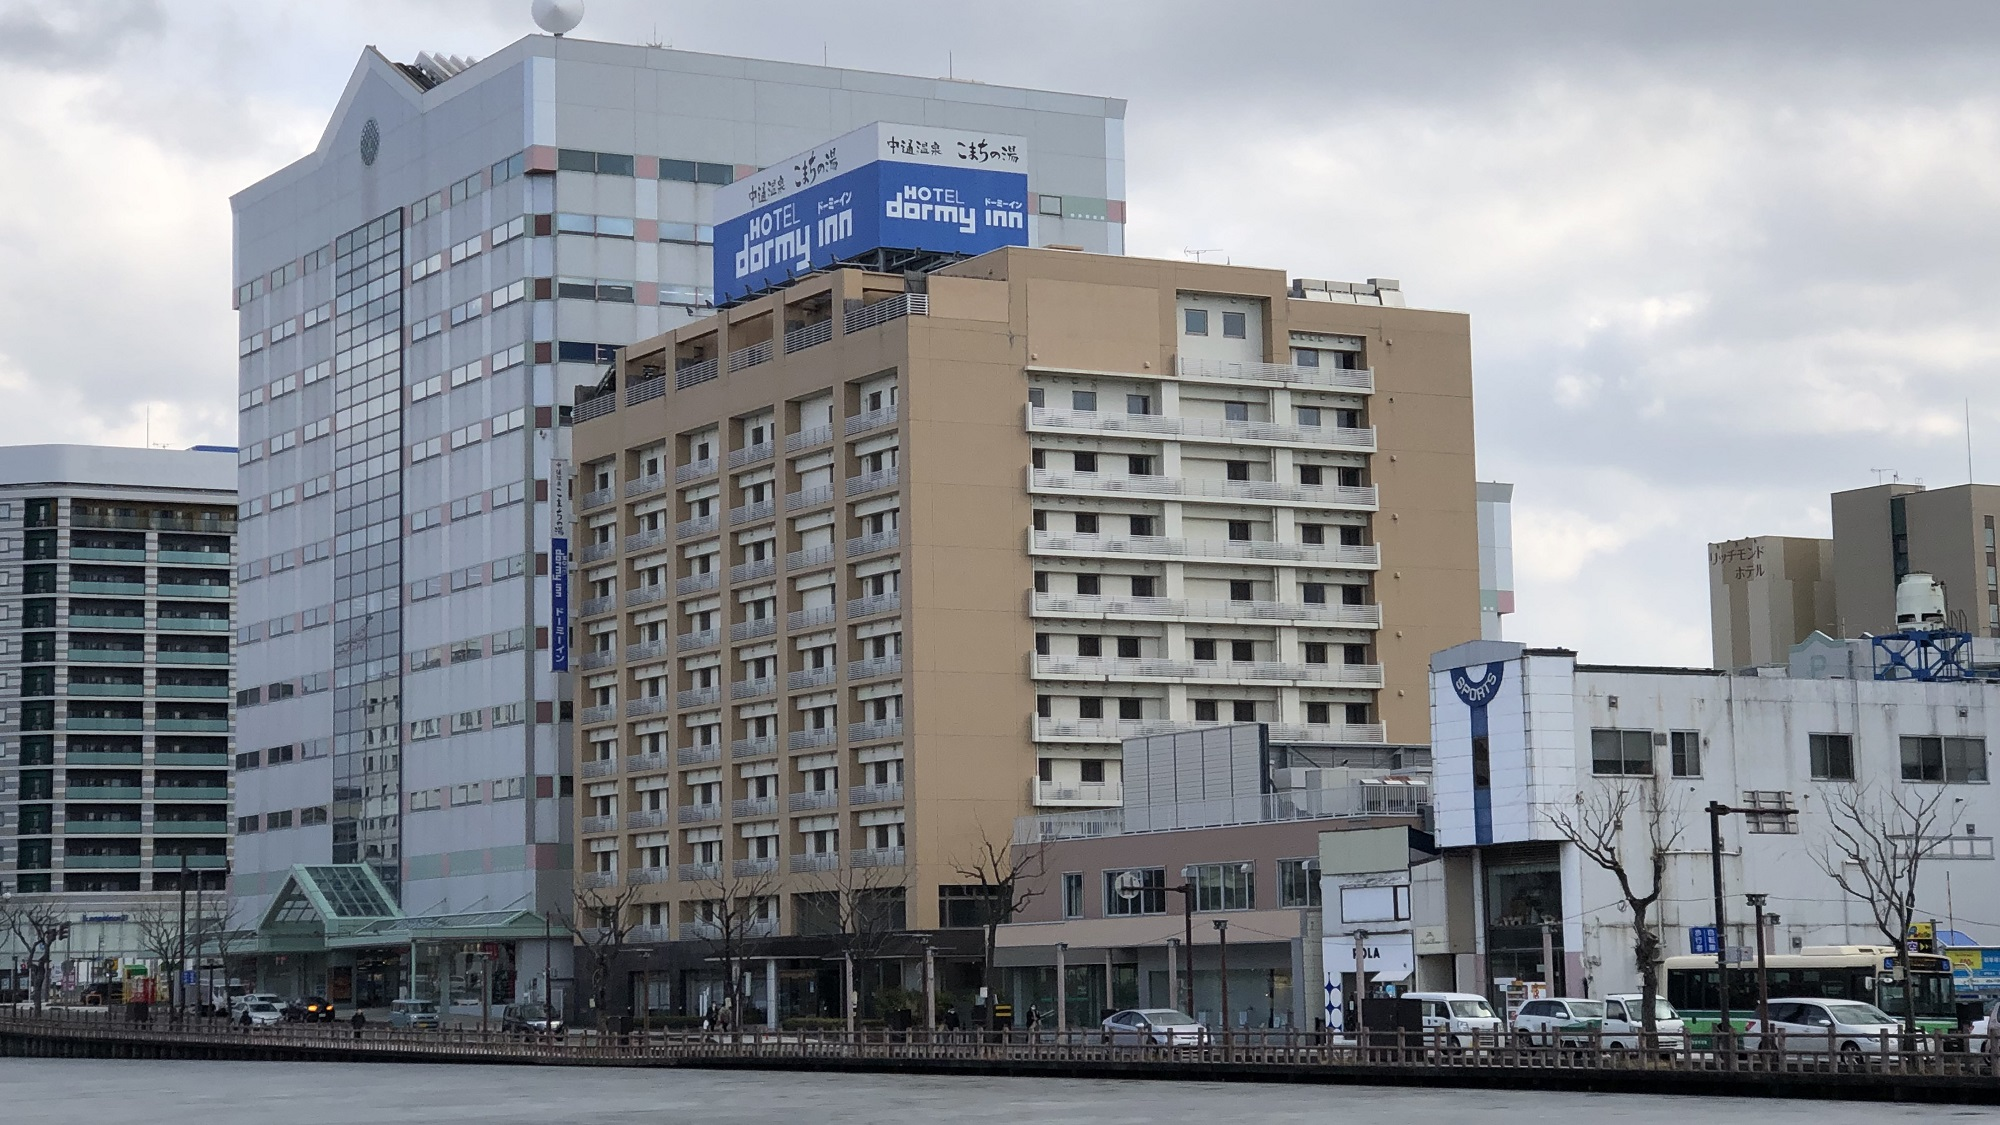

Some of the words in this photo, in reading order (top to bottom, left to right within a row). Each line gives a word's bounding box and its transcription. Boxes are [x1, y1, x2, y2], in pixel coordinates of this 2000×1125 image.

[887, 136, 942, 156] 中通温泉
[957, 138, 1019, 163] こまちの湯
[794, 147, 839, 188] こまちの湯
[817, 191, 852, 215] ドーミーイン
[904, 185, 965, 204] HOTEL
[984, 197, 1023, 210] ドーミーイン
[749, 202, 801, 241] HOTEL
[886, 192, 976, 234] dormy
[985, 209, 1023, 229] inn
[735, 225, 811, 279] dormy
[818, 208, 853, 248] inn
[552, 549, 565, 580] dormy
[1709, 546, 1764, 565] リッチモンド
[1735, 564, 1765, 580] ホテル
[556, 607, 565, 662] ドーミーイン
[1455, 672, 1497, 701] SPORTS
